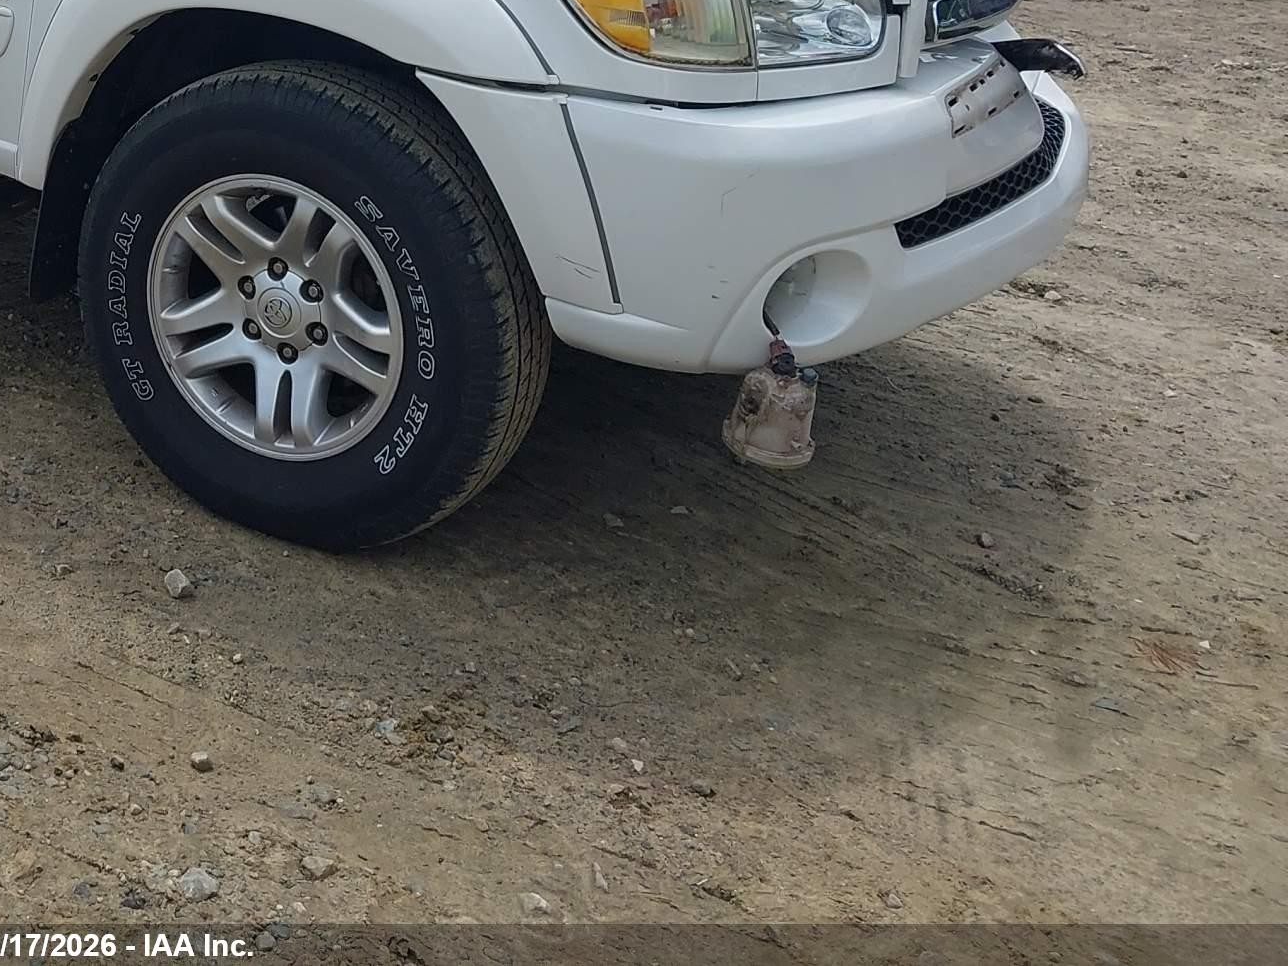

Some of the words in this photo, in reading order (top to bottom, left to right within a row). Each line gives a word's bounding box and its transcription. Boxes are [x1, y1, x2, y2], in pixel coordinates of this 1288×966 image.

[108, 212, 142, 345] RADIAL
[354, 195, 435, 379] SAVERO
[121, 358, 154, 401] GT
[374, 394, 429, 475] HT2
